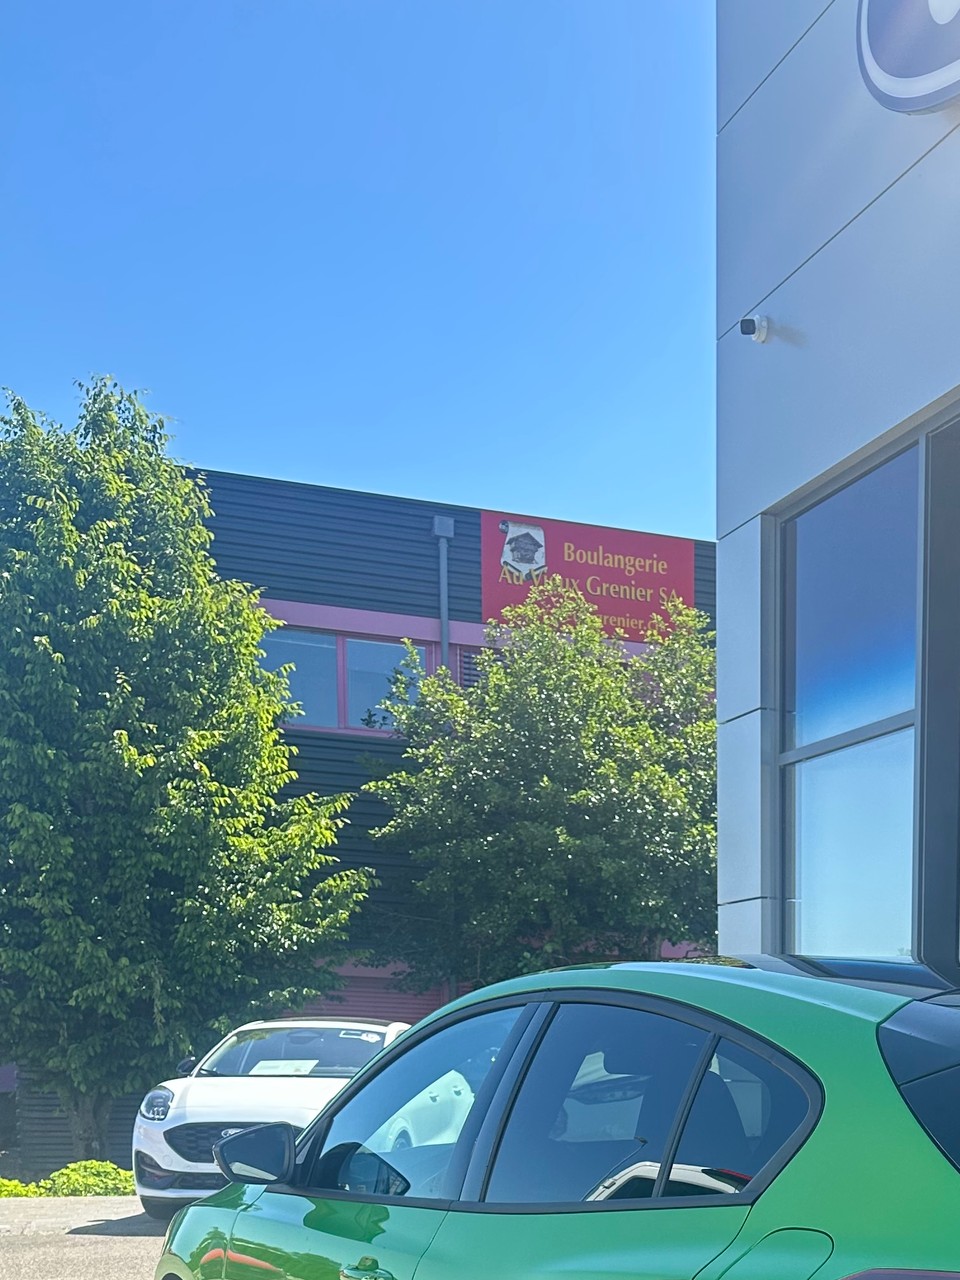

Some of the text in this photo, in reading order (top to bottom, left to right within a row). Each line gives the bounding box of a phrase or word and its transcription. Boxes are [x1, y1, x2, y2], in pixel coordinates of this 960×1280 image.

[563, 542, 668, 575] Boulangerie
[498, 566, 524, 585] Au
[529, 566, 582, 593] Viux
[586, 576, 654, 602] Grenier
